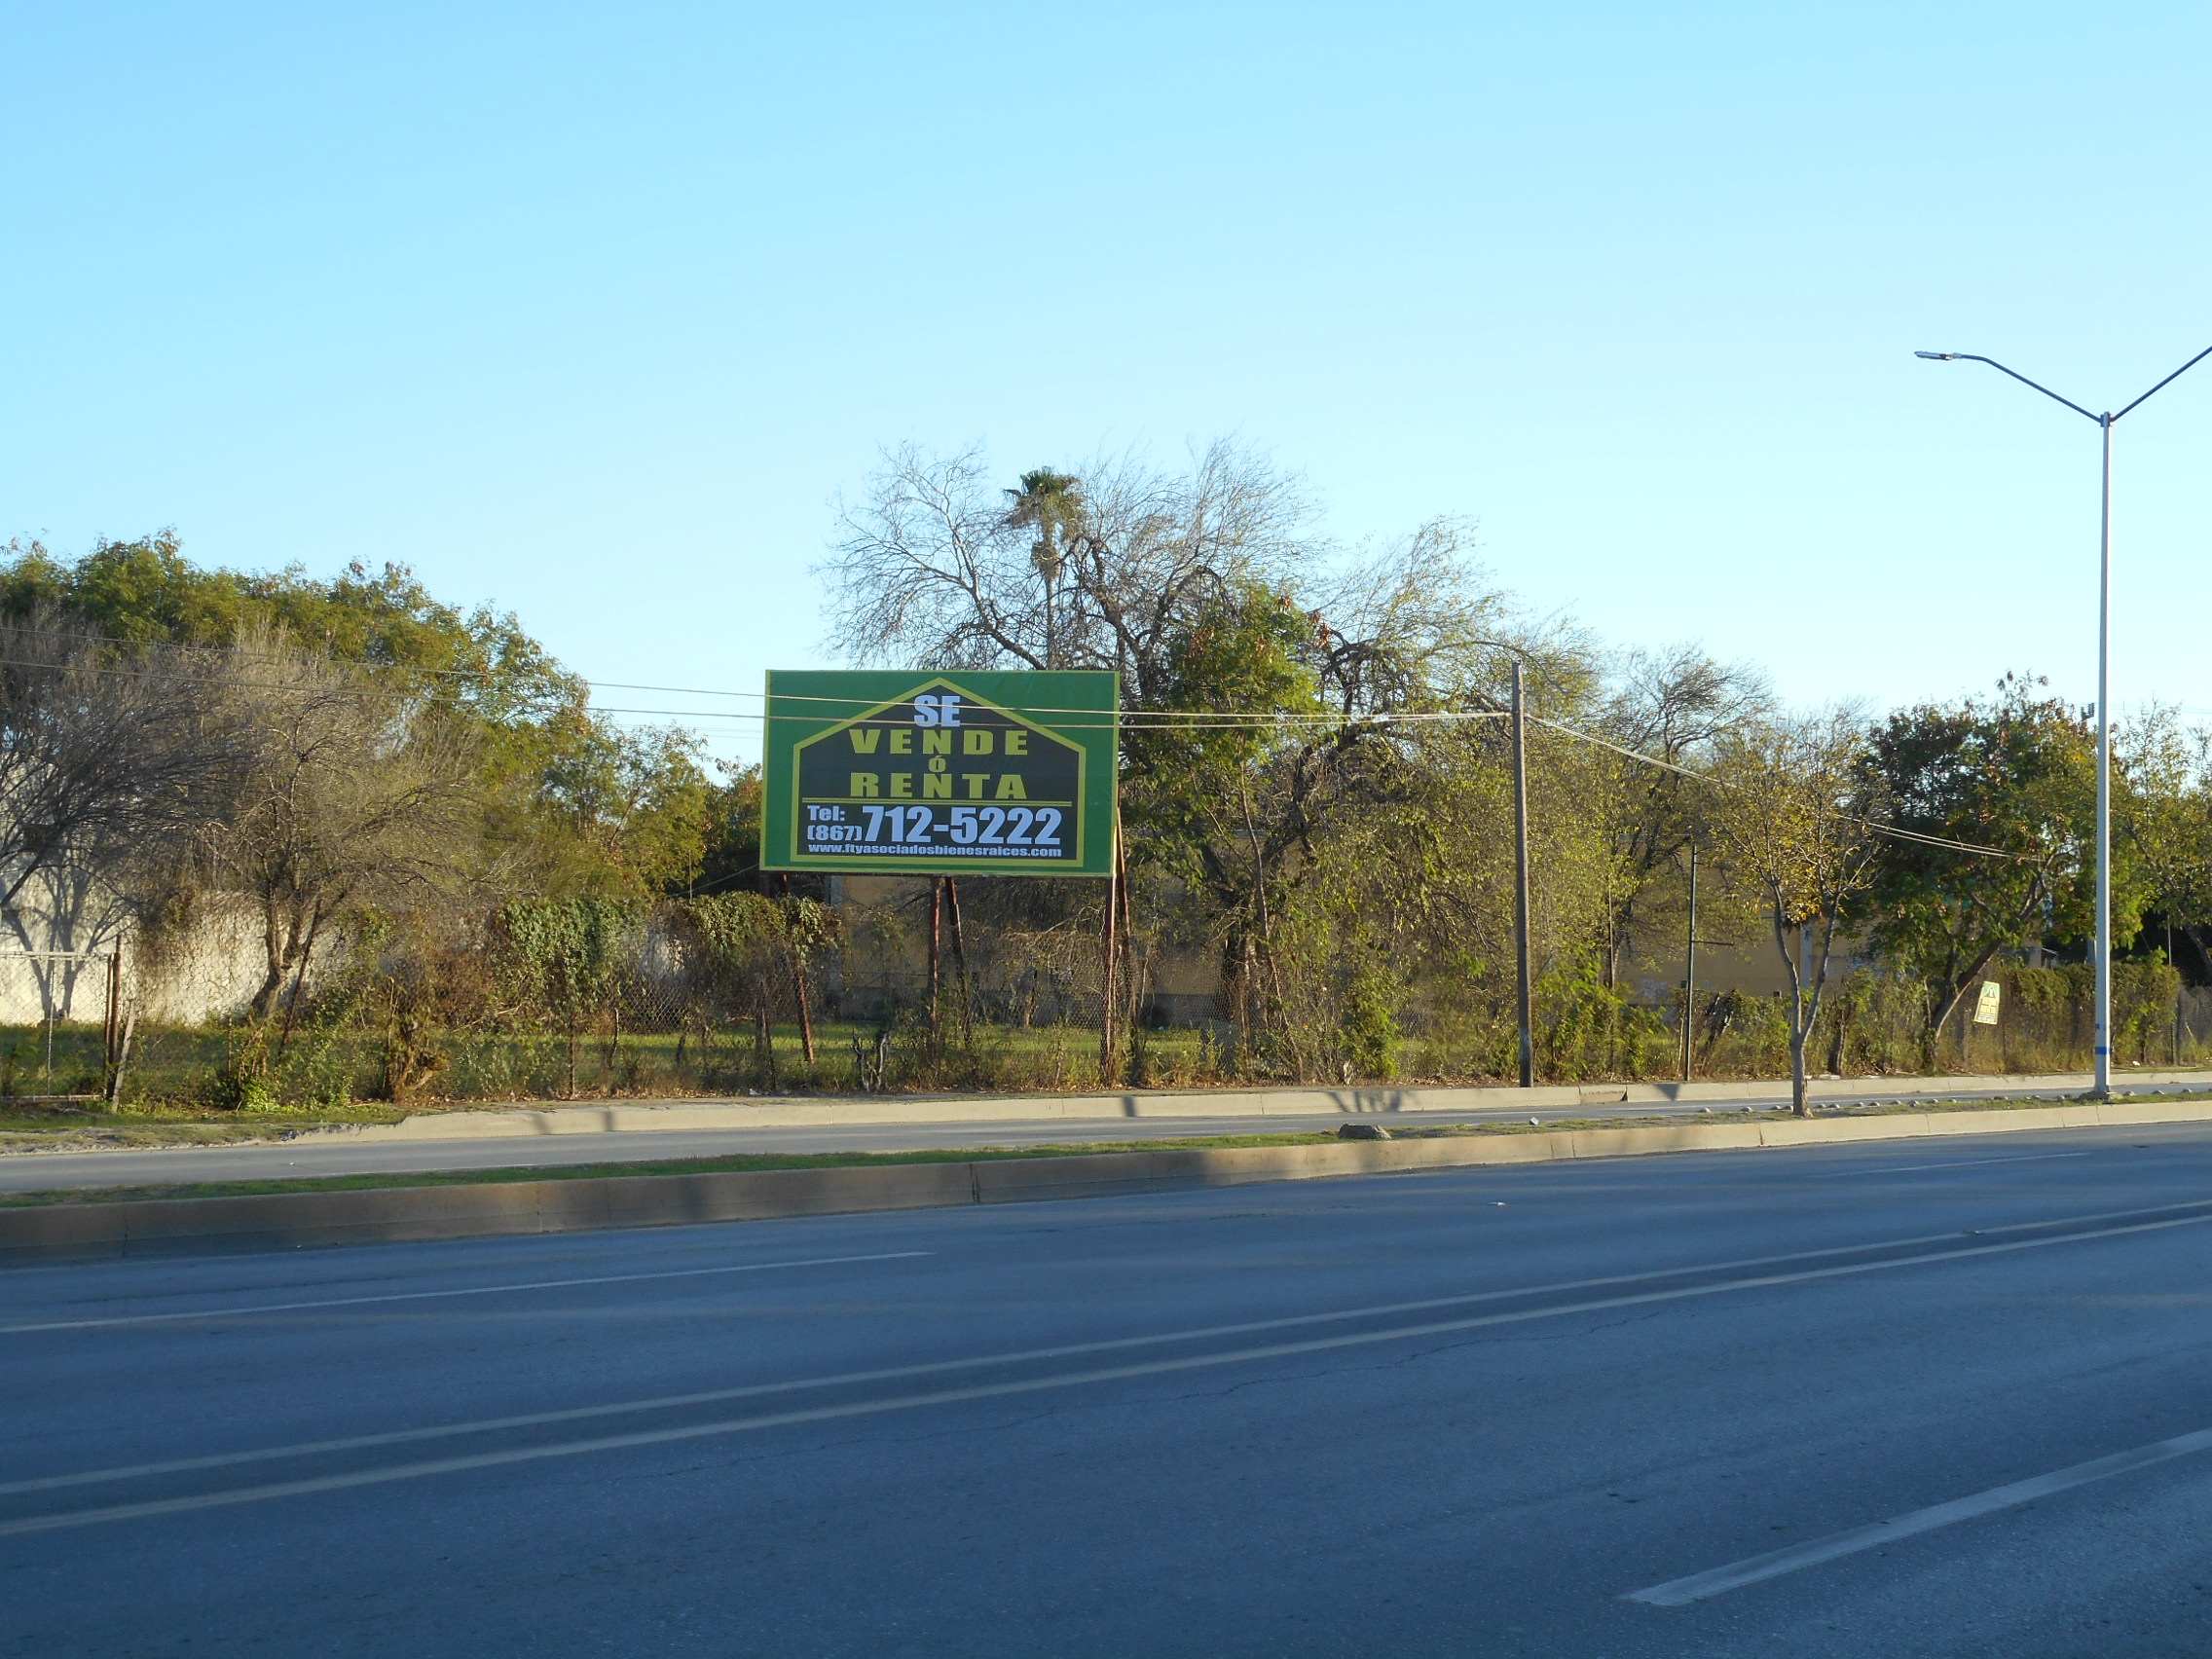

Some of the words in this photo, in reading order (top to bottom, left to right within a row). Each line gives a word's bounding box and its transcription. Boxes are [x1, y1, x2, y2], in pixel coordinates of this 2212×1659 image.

[913, 695, 961, 727] SE
[849, 729, 1028, 756] VENDE
[850, 772, 1027, 799] RENTA
[807, 804, 845, 822] Tel:
[807, 825, 863, 842] (867)
[862, 805, 1062, 845] 712-5222
